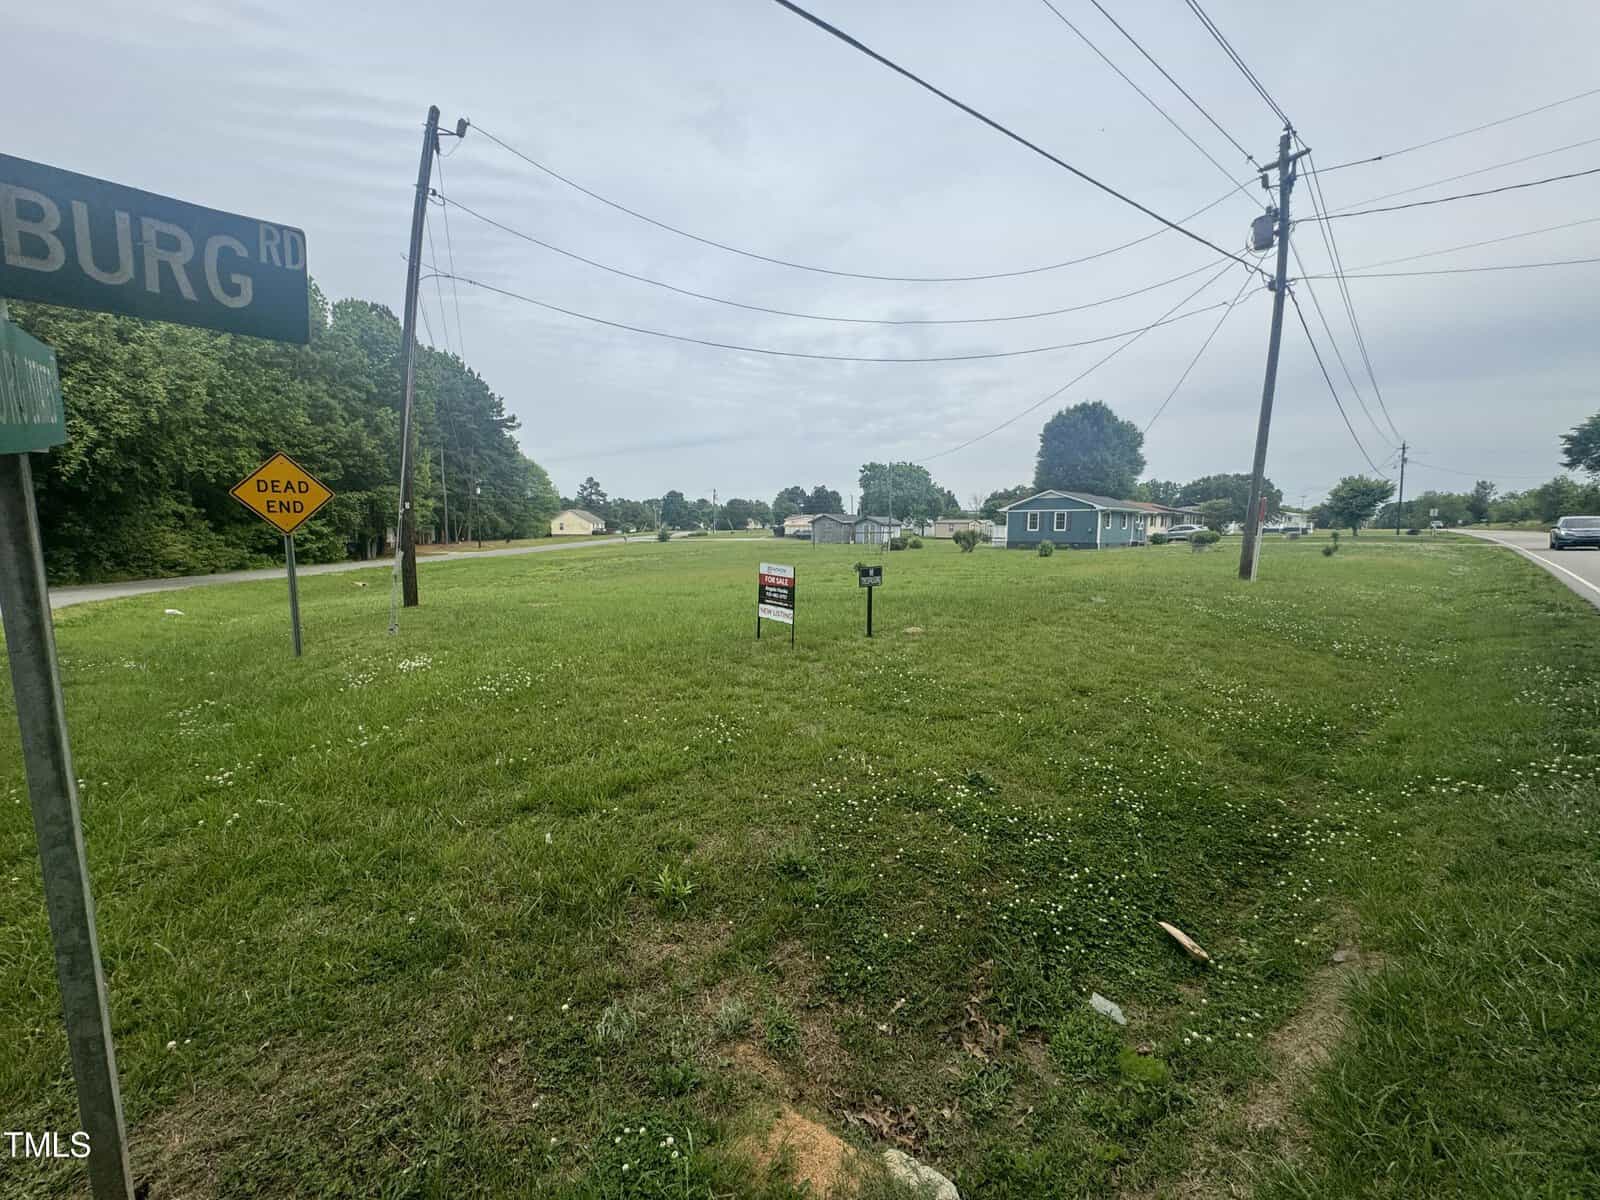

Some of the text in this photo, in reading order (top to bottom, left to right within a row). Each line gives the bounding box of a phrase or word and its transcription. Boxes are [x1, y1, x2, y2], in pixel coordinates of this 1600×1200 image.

[0, 182, 306, 309] BURG RD
[256, 479, 309, 494] DEAD
[266, 500, 304, 514] END
[764, 576, 789, 586] FOR SALE
[760, 607, 772, 616] NEW
